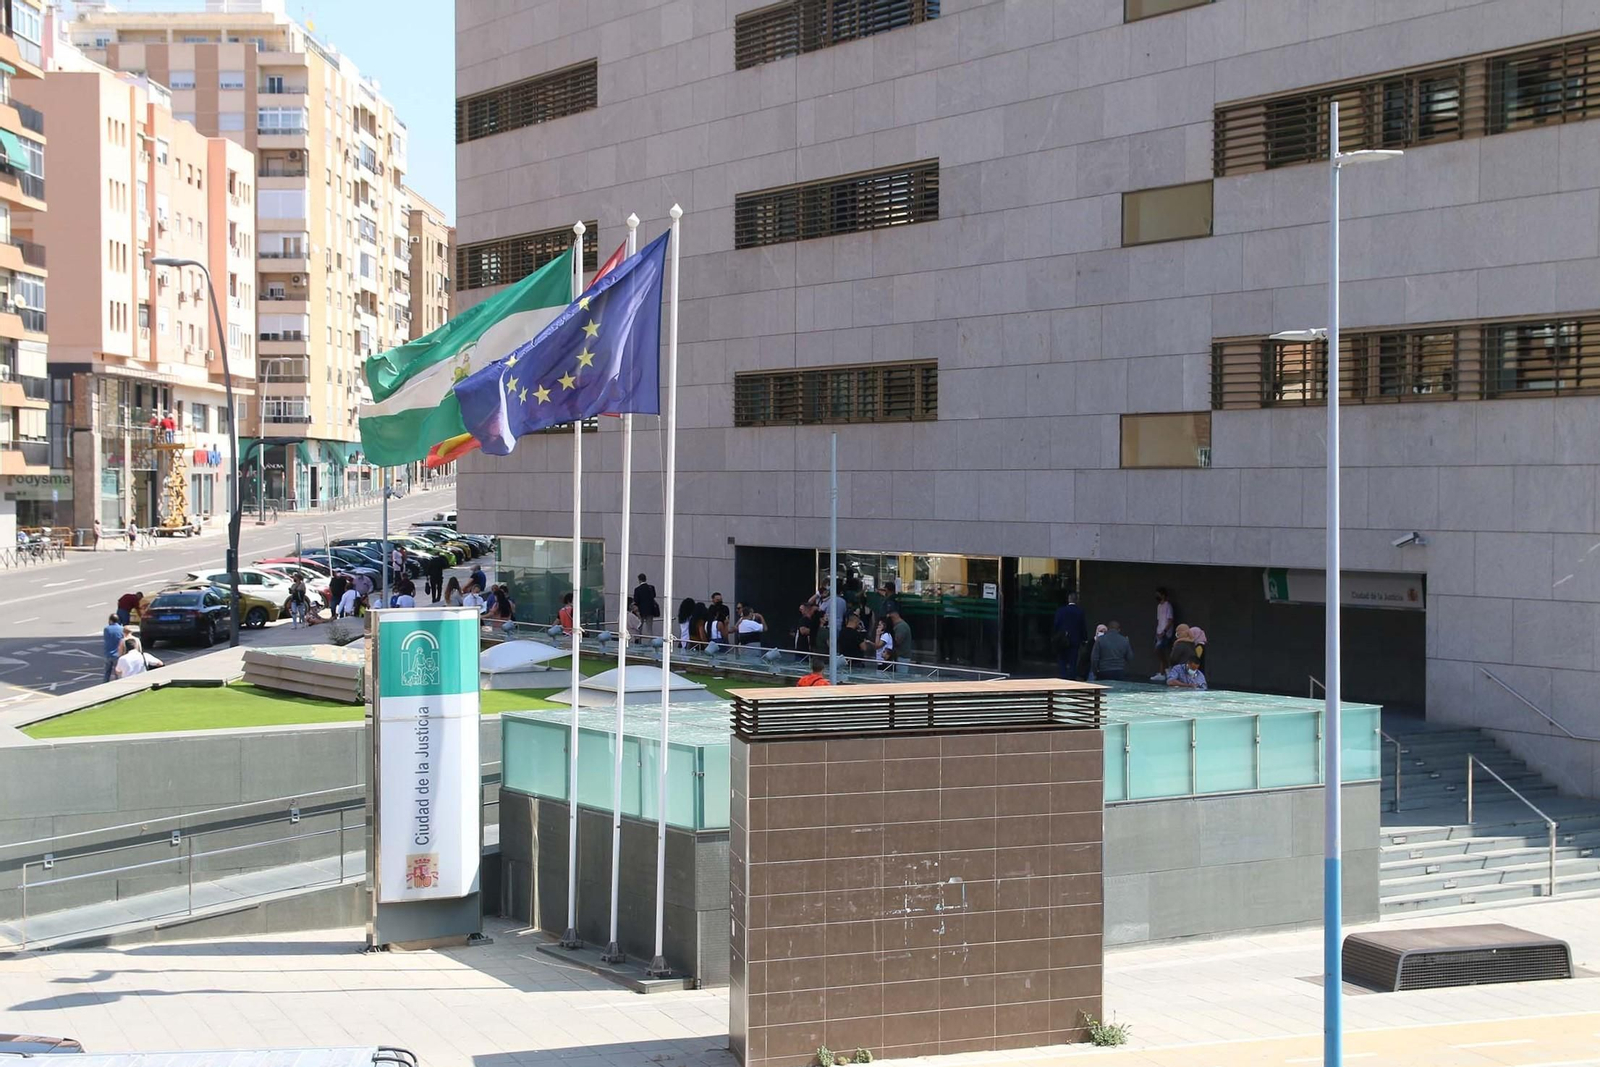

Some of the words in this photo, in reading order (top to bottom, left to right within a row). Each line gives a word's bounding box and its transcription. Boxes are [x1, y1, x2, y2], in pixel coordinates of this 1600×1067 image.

[1351, 591, 1370, 600] Ciudad
[1384, 592, 1404, 601] Justicia
[414, 706, 430, 758] Justicia
[415, 762, 430, 774] la
[415, 778, 430, 795] de
[415, 799, 430, 846] Ciudad
